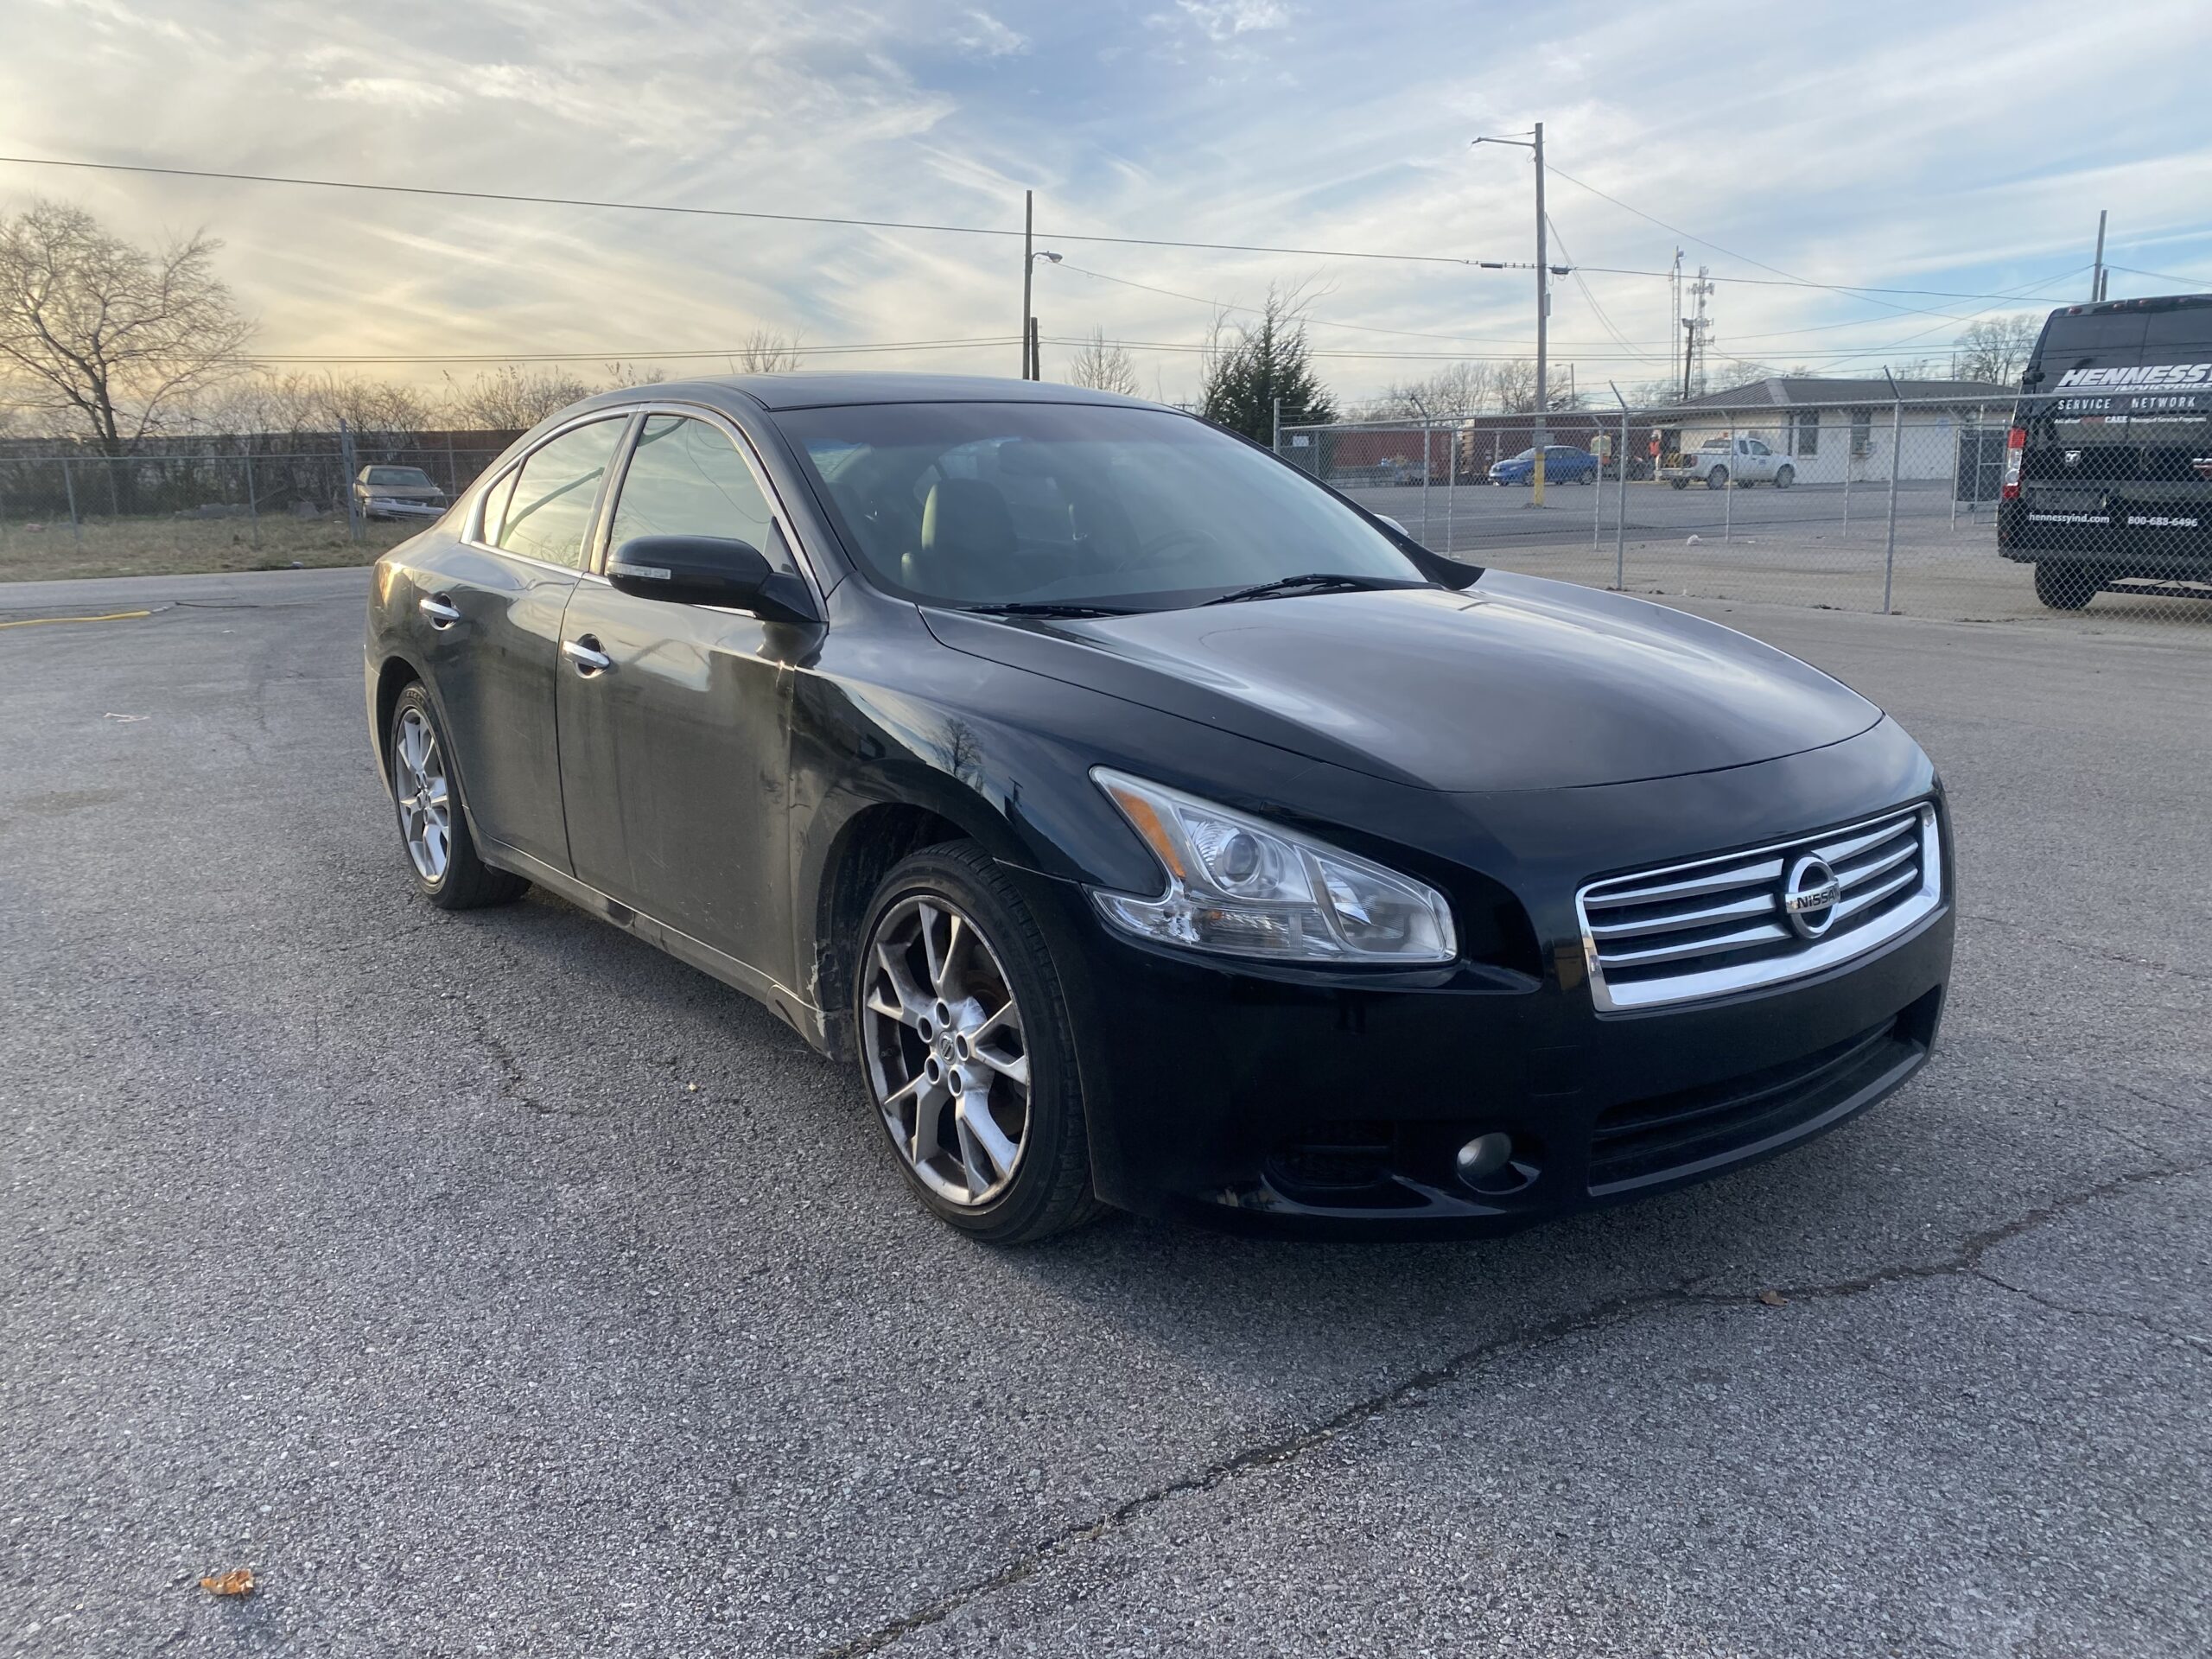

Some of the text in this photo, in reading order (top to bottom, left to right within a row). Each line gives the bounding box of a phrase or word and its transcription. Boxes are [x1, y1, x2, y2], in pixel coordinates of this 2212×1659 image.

[2057, 363, 2212, 387] HENNESS
[2057, 397, 2196, 410] SERVICE NETWORK
[2029, 512, 2198, 527] hennessyind.com 800-688-6496
[1797, 888, 1840, 909] NISSAN
